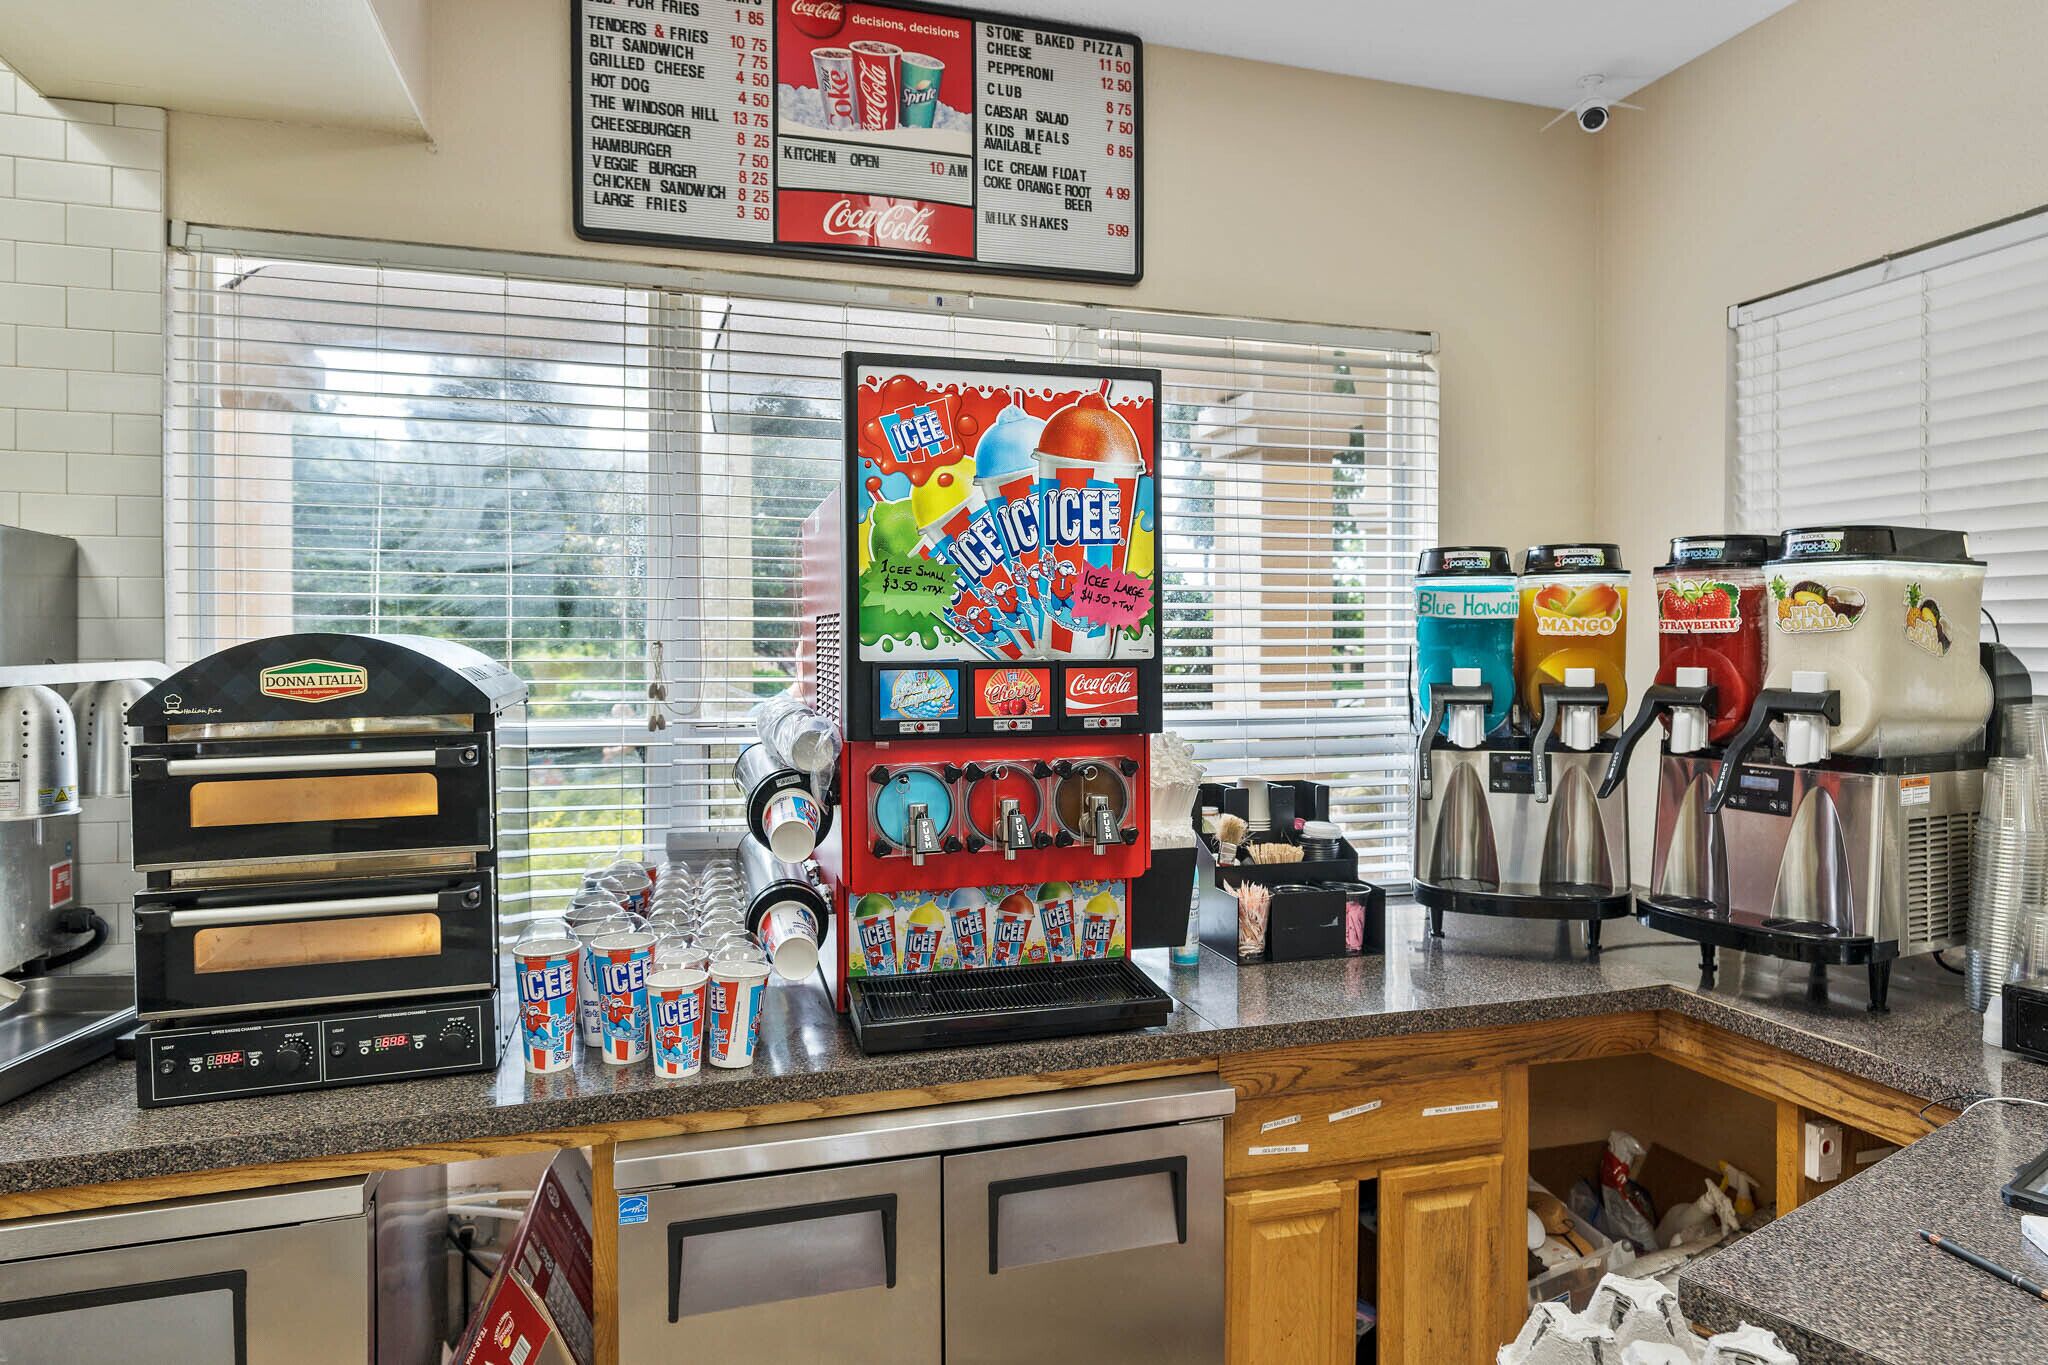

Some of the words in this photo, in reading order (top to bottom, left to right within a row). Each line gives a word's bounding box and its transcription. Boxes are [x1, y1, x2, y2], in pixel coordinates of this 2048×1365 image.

[662, 0, 699, 16] FRIES
[735, 9, 740, 22] 1
[748, 11, 764, 26] 85
[588, 15, 647, 36] TENDERS
[654, 24, 664, 38] &
[670, 27, 709, 44] FRIES
[730, 35, 745, 49] 10
[752, 38, 767, 52] 75
[852, 14, 907, 32] decisions,
[910, 23, 960, 39] decisions
[590, 34, 614, 50] BLT
[622, 37, 694, 60] SANDWICH
[737, 53, 745, 67] 7
[752, 56, 768, 70] 75
[986, 26, 1024, 43] STONE
[1035, 33, 1075, 50] BAKED
[1083, 40, 1123, 58] PIZZA
[589, 51, 645, 71] GRILLED
[654, 60, 705, 79] CHEESE
[736, 71, 744, 84] 4
[753, 73, 769, 87] 50
[987, 42, 1032, 60] CHEESE
[1100, 58, 1112, 72] 11
[1116, 60, 1131, 75] 50
[591, 73, 616, 89] HOT
[621, 76, 650, 93] DOG
[738, 91, 746, 104] 4
[753, 93, 769, 107] 50
[988, 61, 1054, 82] PEPPERONI
[1101, 77, 1114, 90] 12
[1118, 79, 1132, 93] 50
[903, 88, 937, 106] Sprite
[987, 82, 1022, 99] CLUB
[1106, 101, 1114, 114] 8
[1118, 103, 1132, 117] 75
[590, 94, 616, 110] THE
[622, 97, 684, 118] WINDSOR
[691, 106, 719, 122] HILL
[733, 111, 748, 126] 13
[753, 113, 769, 128] 75
[985, 104, 1028, 122] CAESAR
[1036, 110, 1069, 126] SALAD
[1106, 120, 1113, 133] 7
[1120, 121, 1133, 135] 50
[591, 115, 691, 140] CHEESEBURGER
[737, 132, 745, 146] 8
[753, 134, 769, 149] 25
[985, 123, 1015, 139] KIDS
[1025, 127, 1070, 145] MEALS
[592, 136, 672, 158] HAMBURGER
[738, 153, 745, 167] 7
[752, 154, 769, 169] 50
[984, 137, 1041, 156] AVAILABLE
[1107, 144, 1114, 157] 6
[1119, 145, 1133, 159] 85
[592, 154, 638, 173] VEGGIE
[649, 160, 697, 179] BURGER
[739, 171, 747, 185] 8
[752, 172, 768, 186] 25
[783, 146, 836, 164] KITCHEN
[850, 153, 879, 169] OPEN
[929, 162, 944, 176] 10
[949, 164, 968, 178] AM
[984, 158, 1004, 173] ICE
[1010, 161, 1048, 178] CREAM
[1052, 166, 1087, 182] FLOAT
[593, 173, 650, 192] CHICKEN
[660, 179, 726, 200] SANDWICH
[738, 187, 747, 201] 8
[753, 189, 769, 204] 25
[984, 176, 1012, 191] COKE
[1017, 178, 1061, 196] ORANGE
[1065, 185, 1092, 199] ROOT
[1106, 186, 1113, 199] 4
[1117, 187, 1130, 201] 99
[594, 191, 635, 208] LARGE
[646, 196, 688, 214] FRIES
[737, 205, 745, 219] 3
[753, 207, 770, 221] 50
[1065, 198, 1092, 213] BEER
[823, 199, 935, 244] Coca-Cola
[985, 211, 1016, 227] MILK
[1021, 214, 1068, 231] SHAKES
[891, 411, 946, 455] ICEE
[1043, 488, 1122, 546] ICEE
[882, 574, 918, 594] $3.50
[1080, 587, 1111, 604] $4.50
[1084, 570, 1110, 588] ICEE
[1114, 581, 1144, 602] LARGE
[1419, 592, 1456, 616] Blue
[1463, 594, 1519, 617] Hawaii
[1791, 601, 1833, 619] PIÑA
[1541, 618, 1614, 633] MANGO
[1660, 620, 1737, 630] STRAWBERRY
[1782, 615, 1851, 631] COLADA
[265, 675, 315, 688] DONNA
[318, 674, 363, 686] ITALIA
[985, 683, 1041, 703] Cherry
[1070, 671, 1134, 696] Coca-Cola
[922, 821, 932, 849] PUSH
[1016, 817, 1025, 845] PUSH
[1103, 813, 1113, 840] PUSH
[954, 914, 984, 939] ICEE
[1042, 905, 1071, 930] ICEE
[862, 923, 894, 947] ICEE
[908, 934, 936, 952] ICEE
[998, 921, 1025, 942] ICEE
[1084, 921, 1111, 941] ICEE
[520, 963, 573, 1002] ICEE
[657, 994, 700, 1027] ICEE
